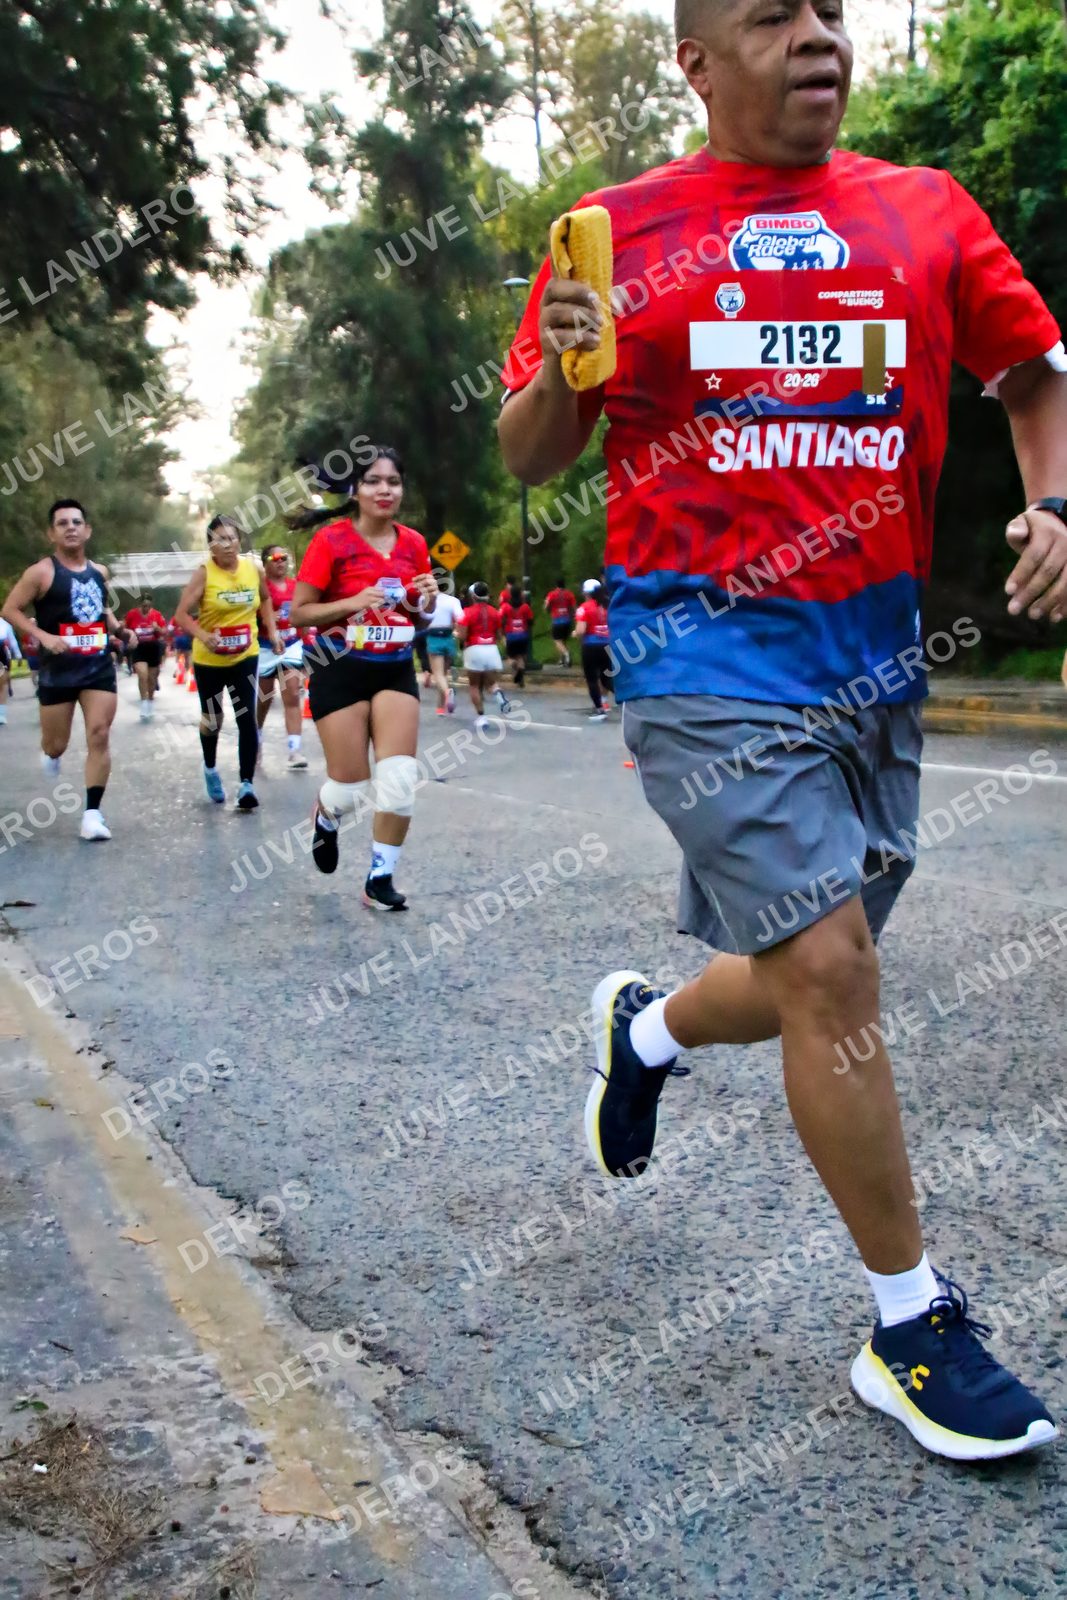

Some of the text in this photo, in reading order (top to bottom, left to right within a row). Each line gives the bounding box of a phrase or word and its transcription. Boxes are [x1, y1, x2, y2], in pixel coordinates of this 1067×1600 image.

[756, 219, 815, 229] BIMBO
[758, 235, 817, 247] Global
[748, 245, 797, 257] Race
[760, 324, 842, 364] 2132
[708, 422, 905, 473] SANTIAGO
